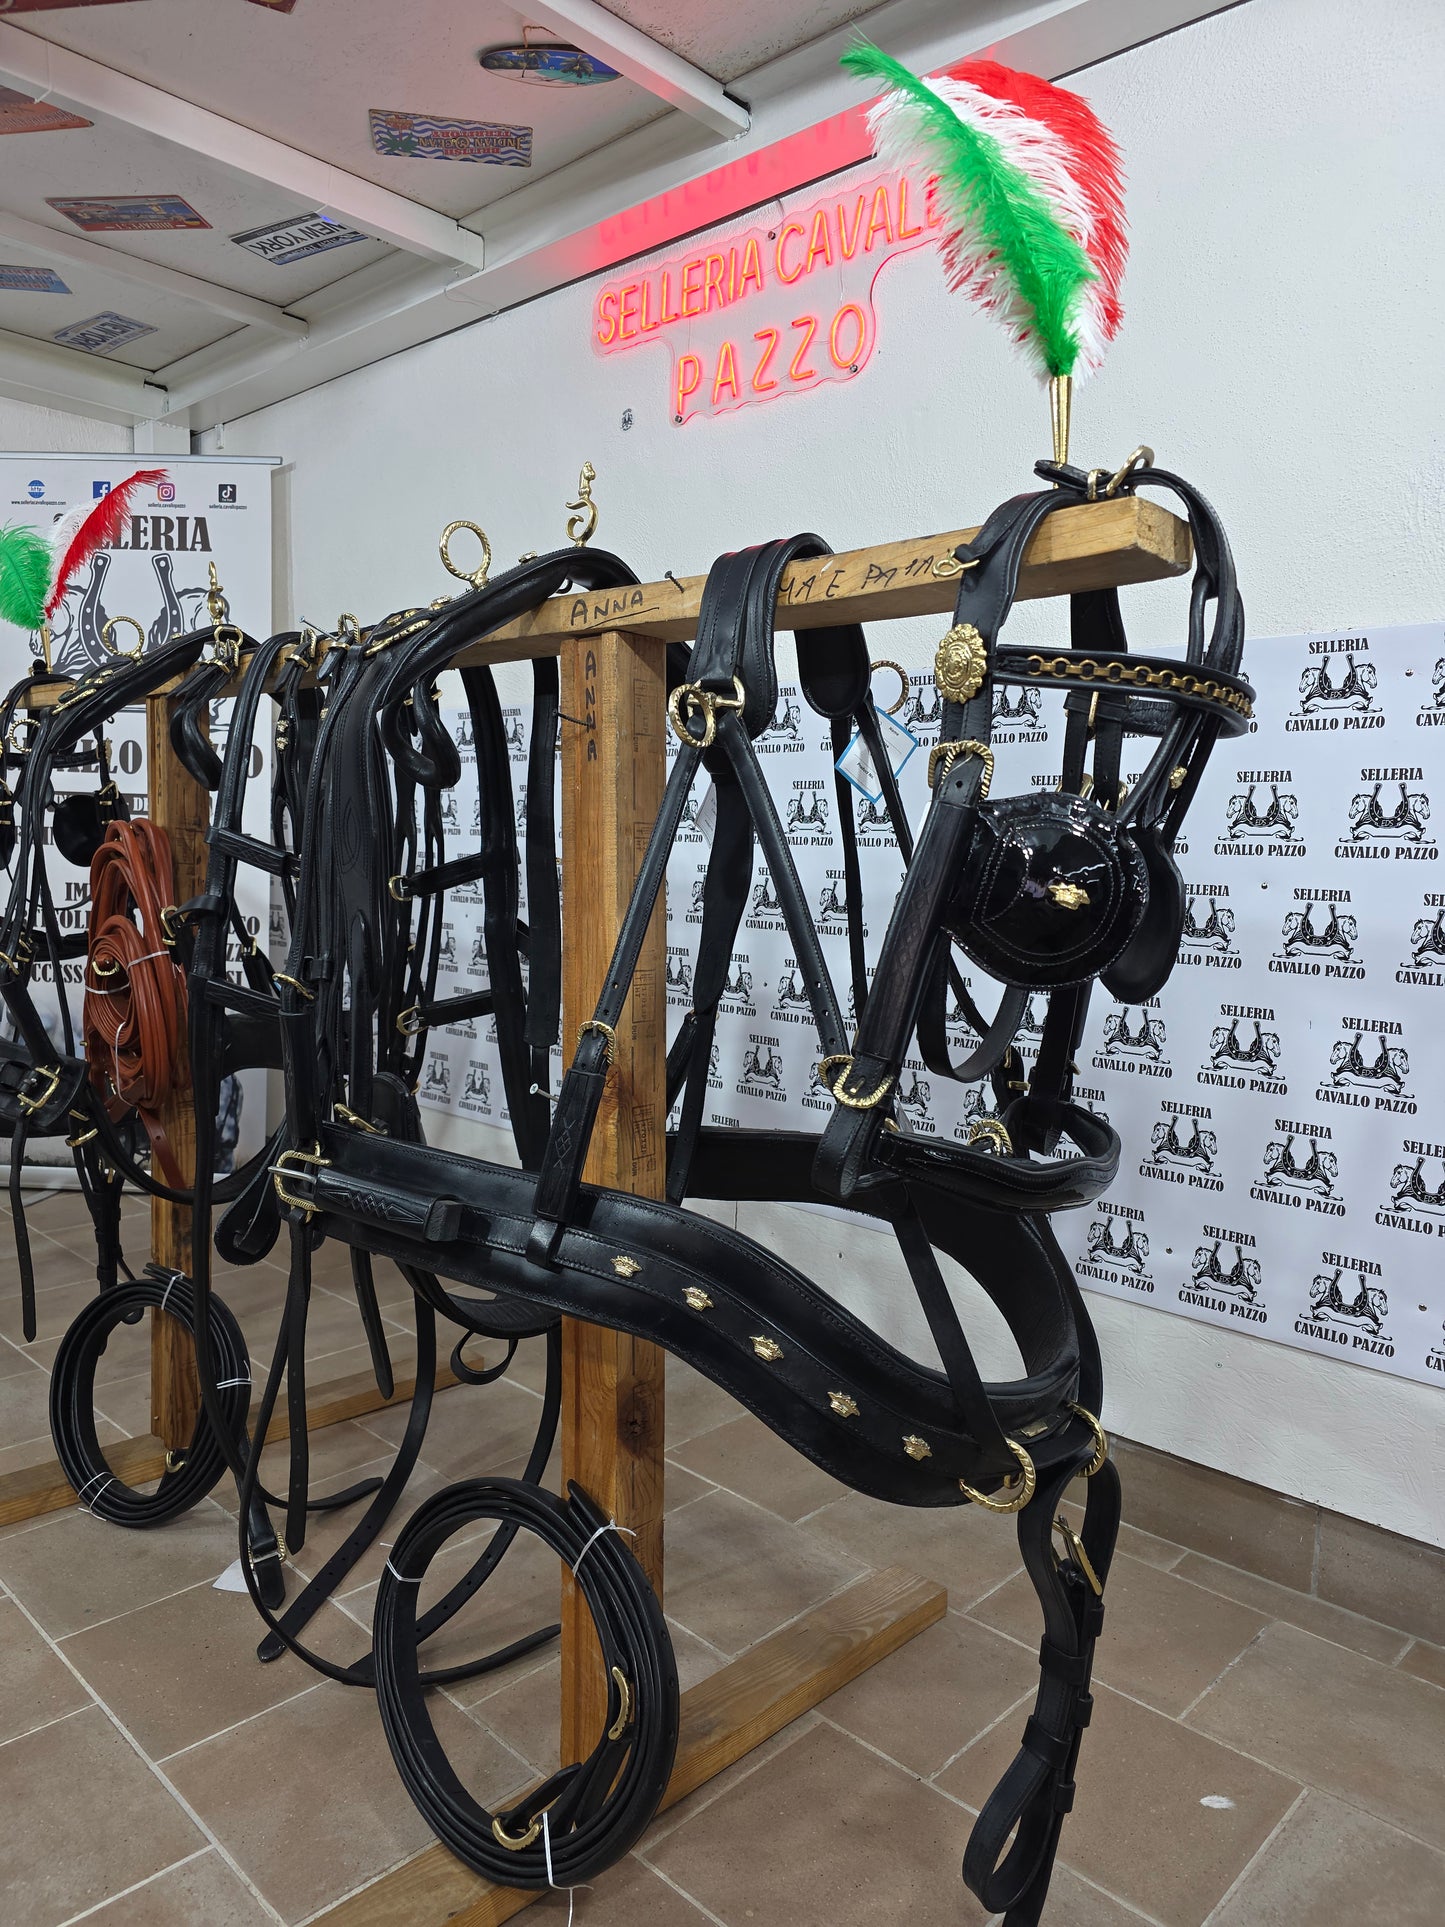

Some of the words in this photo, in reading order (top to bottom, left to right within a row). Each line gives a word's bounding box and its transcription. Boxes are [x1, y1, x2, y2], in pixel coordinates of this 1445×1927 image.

[248, 232, 308, 255] YORK
[597, 238, 763, 345] SELLERIA
[676, 304, 865, 415] PAZZO
[825, 570, 845, 598] E
[570, 589, 644, 626] ANNA
[1309, 638, 1369, 654] SELLERIA
[585, 650, 598, 762] ANNA
[1285, 718, 1339, 732] CAVALLO
[1343, 716, 1386, 730] PAZZO
[1018, 732, 1048, 743] PAZZO
[783, 743, 804, 752] PAZZO
[512, 754, 528, 762] PAZZO
[1236, 770, 1292, 783] SELLERIA
[1361, 768, 1423, 781] SELLERIA
[792, 780, 824, 790] SELLERIA
[684, 834, 703, 842] PAZZO
[811, 836, 834, 846] PAZZO
[1214, 844, 1264, 856] CAVALLO
[1268, 844, 1306, 857] PAZZO
[1334, 846, 1390, 860] CAVALLO
[1395, 846, 1439, 860] PAZZO
[1184, 884, 1230, 897] ELLERIA
[1294, 888, 1352, 902] SELLERIA
[746, 920, 773, 930] CAVALLO
[445, 964, 458, 973] PAZZO
[1205, 956, 1242, 969] PAZZO
[1268, 960, 1321, 976] CAVALLO
[1324, 968, 1366, 980] PAZZO
[467, 968, 484, 977] CAVALLO
[1396, 970, 1445, 987] CAVALL
[736, 1006, 756, 1016] PAZZO
[770, 1011, 799, 1023] CAVALLO
[1220, 1004, 1275, 1021] SELLERIA
[446, 1027, 462, 1036] CAVALLO
[464, 1030, 478, 1040] PAZZO
[1342, 1017, 1403, 1036] SELLERIA
[749, 1034, 780, 1047] SELLERIA
[954, 1038, 980, 1050] PAZZO
[430, 1052, 448, 1062] SELLERIA
[470, 1060, 488, 1071] SELLERIA
[1092, 1058, 1136, 1072] CAVALLO
[1138, 1064, 1173, 1078] PAZZO
[1197, 1072, 1246, 1089] CAVALLO
[1250, 1079, 1288, 1096] PAZZO
[420, 1090, 437, 1102] CAVALLO
[438, 1094, 450, 1104] PAZZO
[736, 1084, 764, 1097] CAVALLO
[766, 1089, 787, 1102] PAZZO
[459, 1100, 476, 1112] CAVALLO
[478, 1105, 492, 1116] PAZZO
[802, 1098, 832, 1112] CAVALLO
[1161, 1100, 1212, 1119] SELLERIA
[1316, 1089, 1370, 1108] CAVALLO
[1374, 1098, 1418, 1115] PAZZO
[711, 1114, 740, 1128] SELLERIA
[1274, 1118, 1332, 1140] SELLERIA
[1139, 1165, 1184, 1184] CAVALLO
[1188, 1175, 1224, 1192] PAZZO
[1250, 1188, 1302, 1208] CAVALLO
[1306, 1198, 1346, 1216] PAZZO
[1097, 1201, 1145, 1222] SELLERIA
[1375, 1213, 1432, 1235] CAVALLO
[1203, 1224, 1256, 1248] SELLERIA
[1322, 1252, 1382, 1276] SELLERIA
[1075, 1262, 1118, 1284] CAVALLO
[1122, 1275, 1154, 1294] PAZZO
[1178, 1290, 1226, 1312] CAVALLO
[1230, 1304, 1268, 1324] PAZZO
[1294, 1320, 1348, 1345] CAVALLO
[1352, 1336, 1395, 1358] PAZZO
